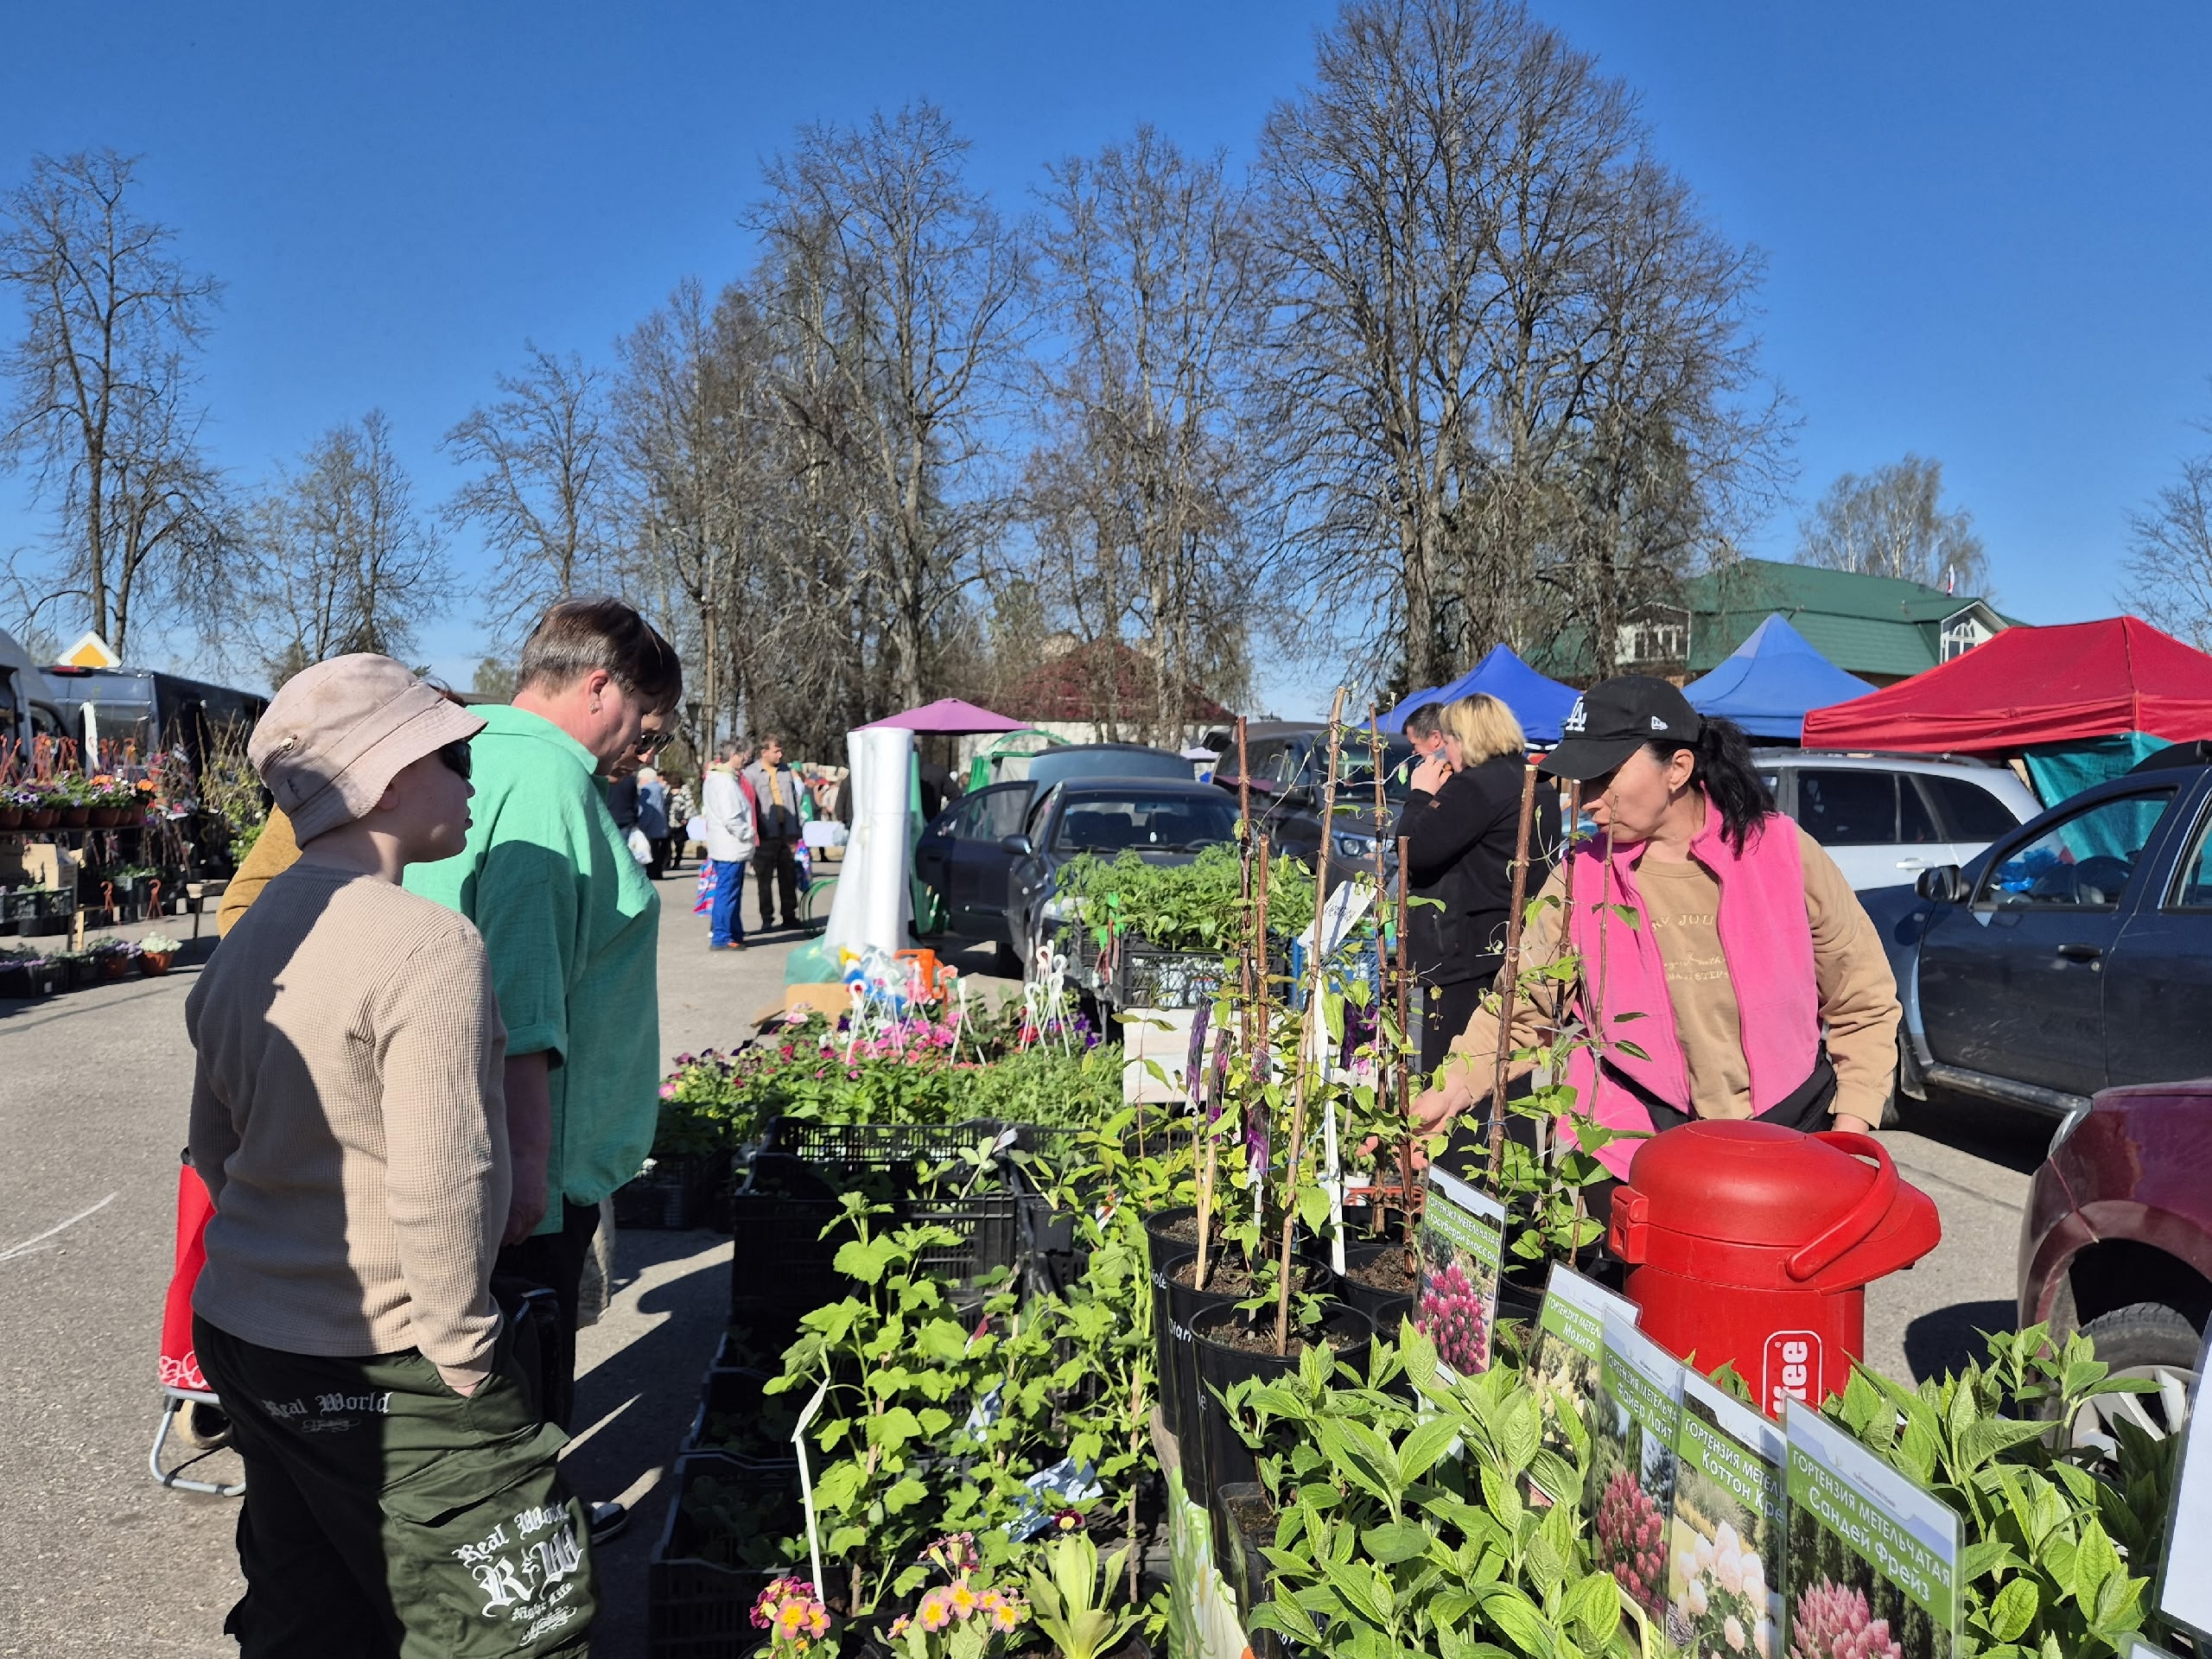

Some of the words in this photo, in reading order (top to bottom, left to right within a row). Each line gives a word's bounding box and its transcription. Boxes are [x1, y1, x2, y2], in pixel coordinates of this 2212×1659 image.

[1565, 696, 1587, 732] LA
[1426, 1208, 1465, 1242] Строуберри
[1466, 1235, 1497, 1263] Блоссом
[1427, 1195, 1457, 1221] ГОРТЕНЗИЯ
[1458, 1214, 1500, 1249] МЕТЕЛЬЧАТАЯ
[1547, 1296, 1579, 1324] ГОРТЕНЗИЯ
[1562, 1322, 1596, 1353] Мохито
[1605, 1351, 1639, 1392] ГОРТЕНЗИЯ
[315, 1391, 394, 1417] World
[1617, 1382, 1646, 1420] Файер
[1648, 1414, 1673, 1441] Лайт
[1685, 1417, 1740, 1469] ГОРТЕНЗИЯ
[1702, 1449, 1751, 1501] Коттон
[451, 1523, 511, 1569] Real
[513, 1503, 570, 1541] Worl
[1793, 1451, 1855, 1512] ГОРТЕНЗИЯ
[1859, 1503, 1950, 1588] МЕТЕЛЬЧАТАЯ
[1809, 1486, 1871, 1553] Сандей
[1875, 1541, 1929, 1601] Фрейз
